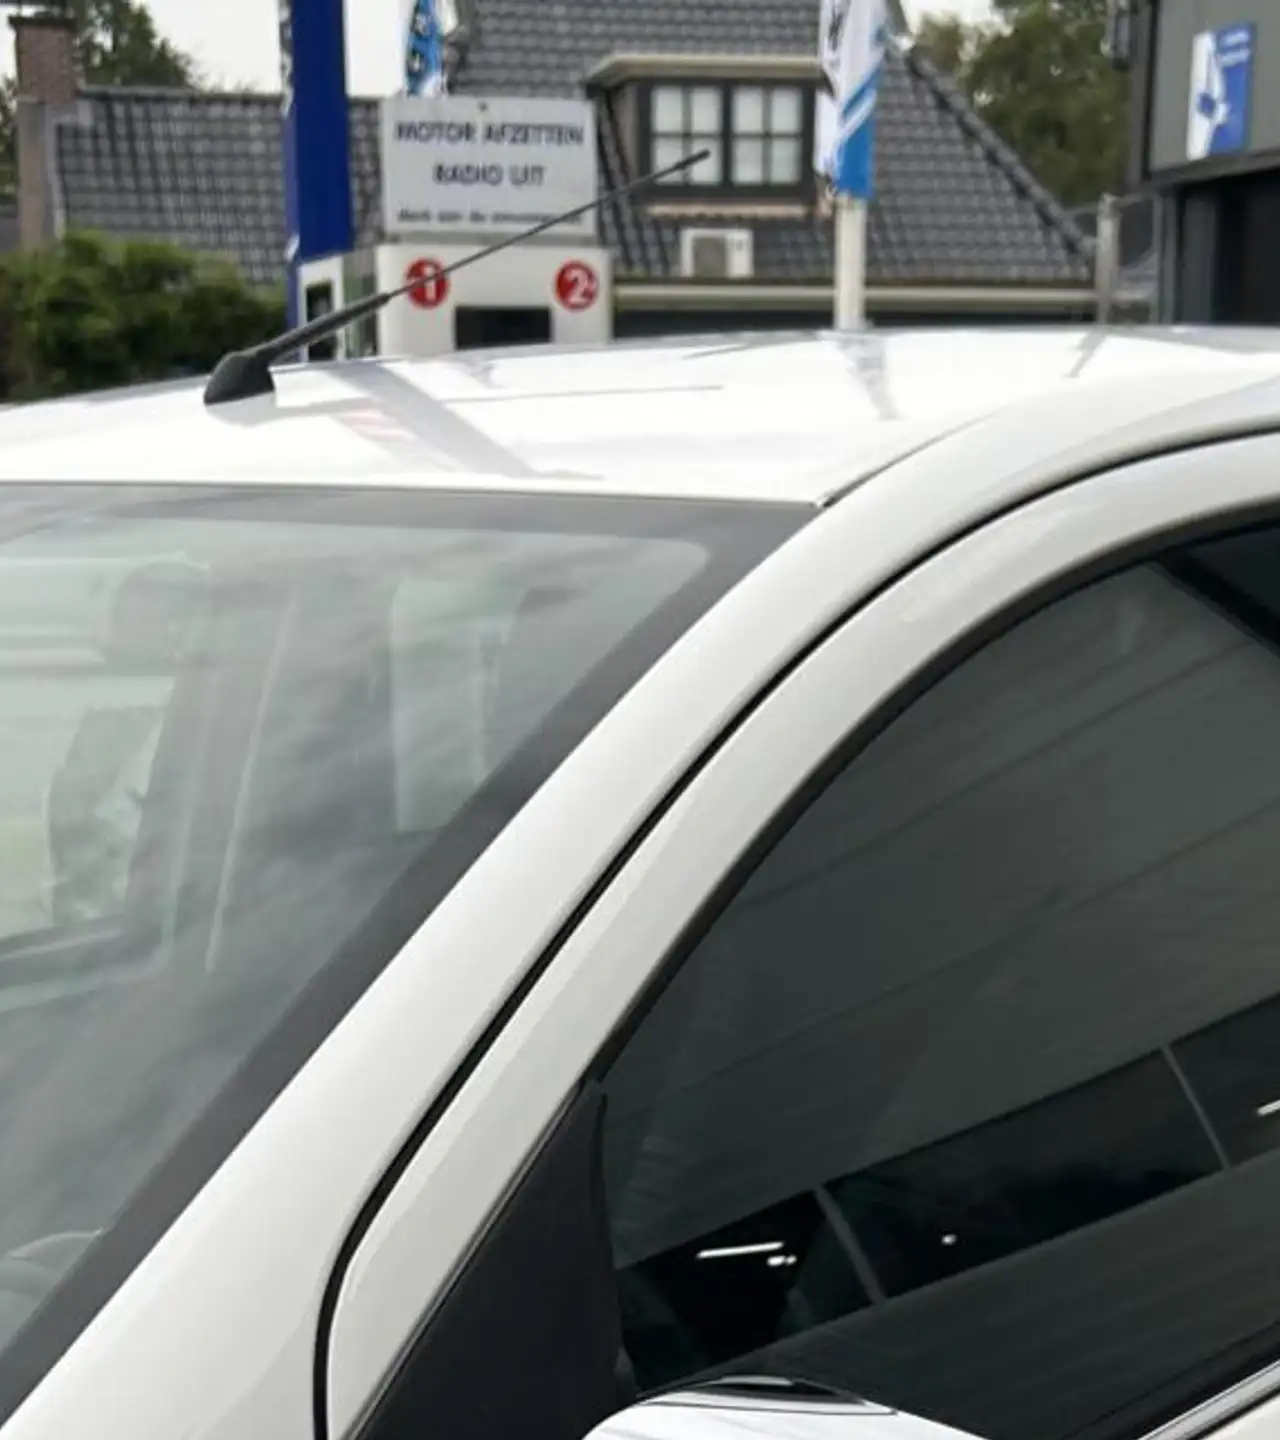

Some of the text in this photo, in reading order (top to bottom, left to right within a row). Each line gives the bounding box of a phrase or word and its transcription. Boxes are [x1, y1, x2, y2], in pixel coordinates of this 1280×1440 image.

[396, 121, 584, 144] MOTOR AFZETTEN
[434, 163, 546, 186] RADIO UIT
[564, 268, 595, 303] 2
